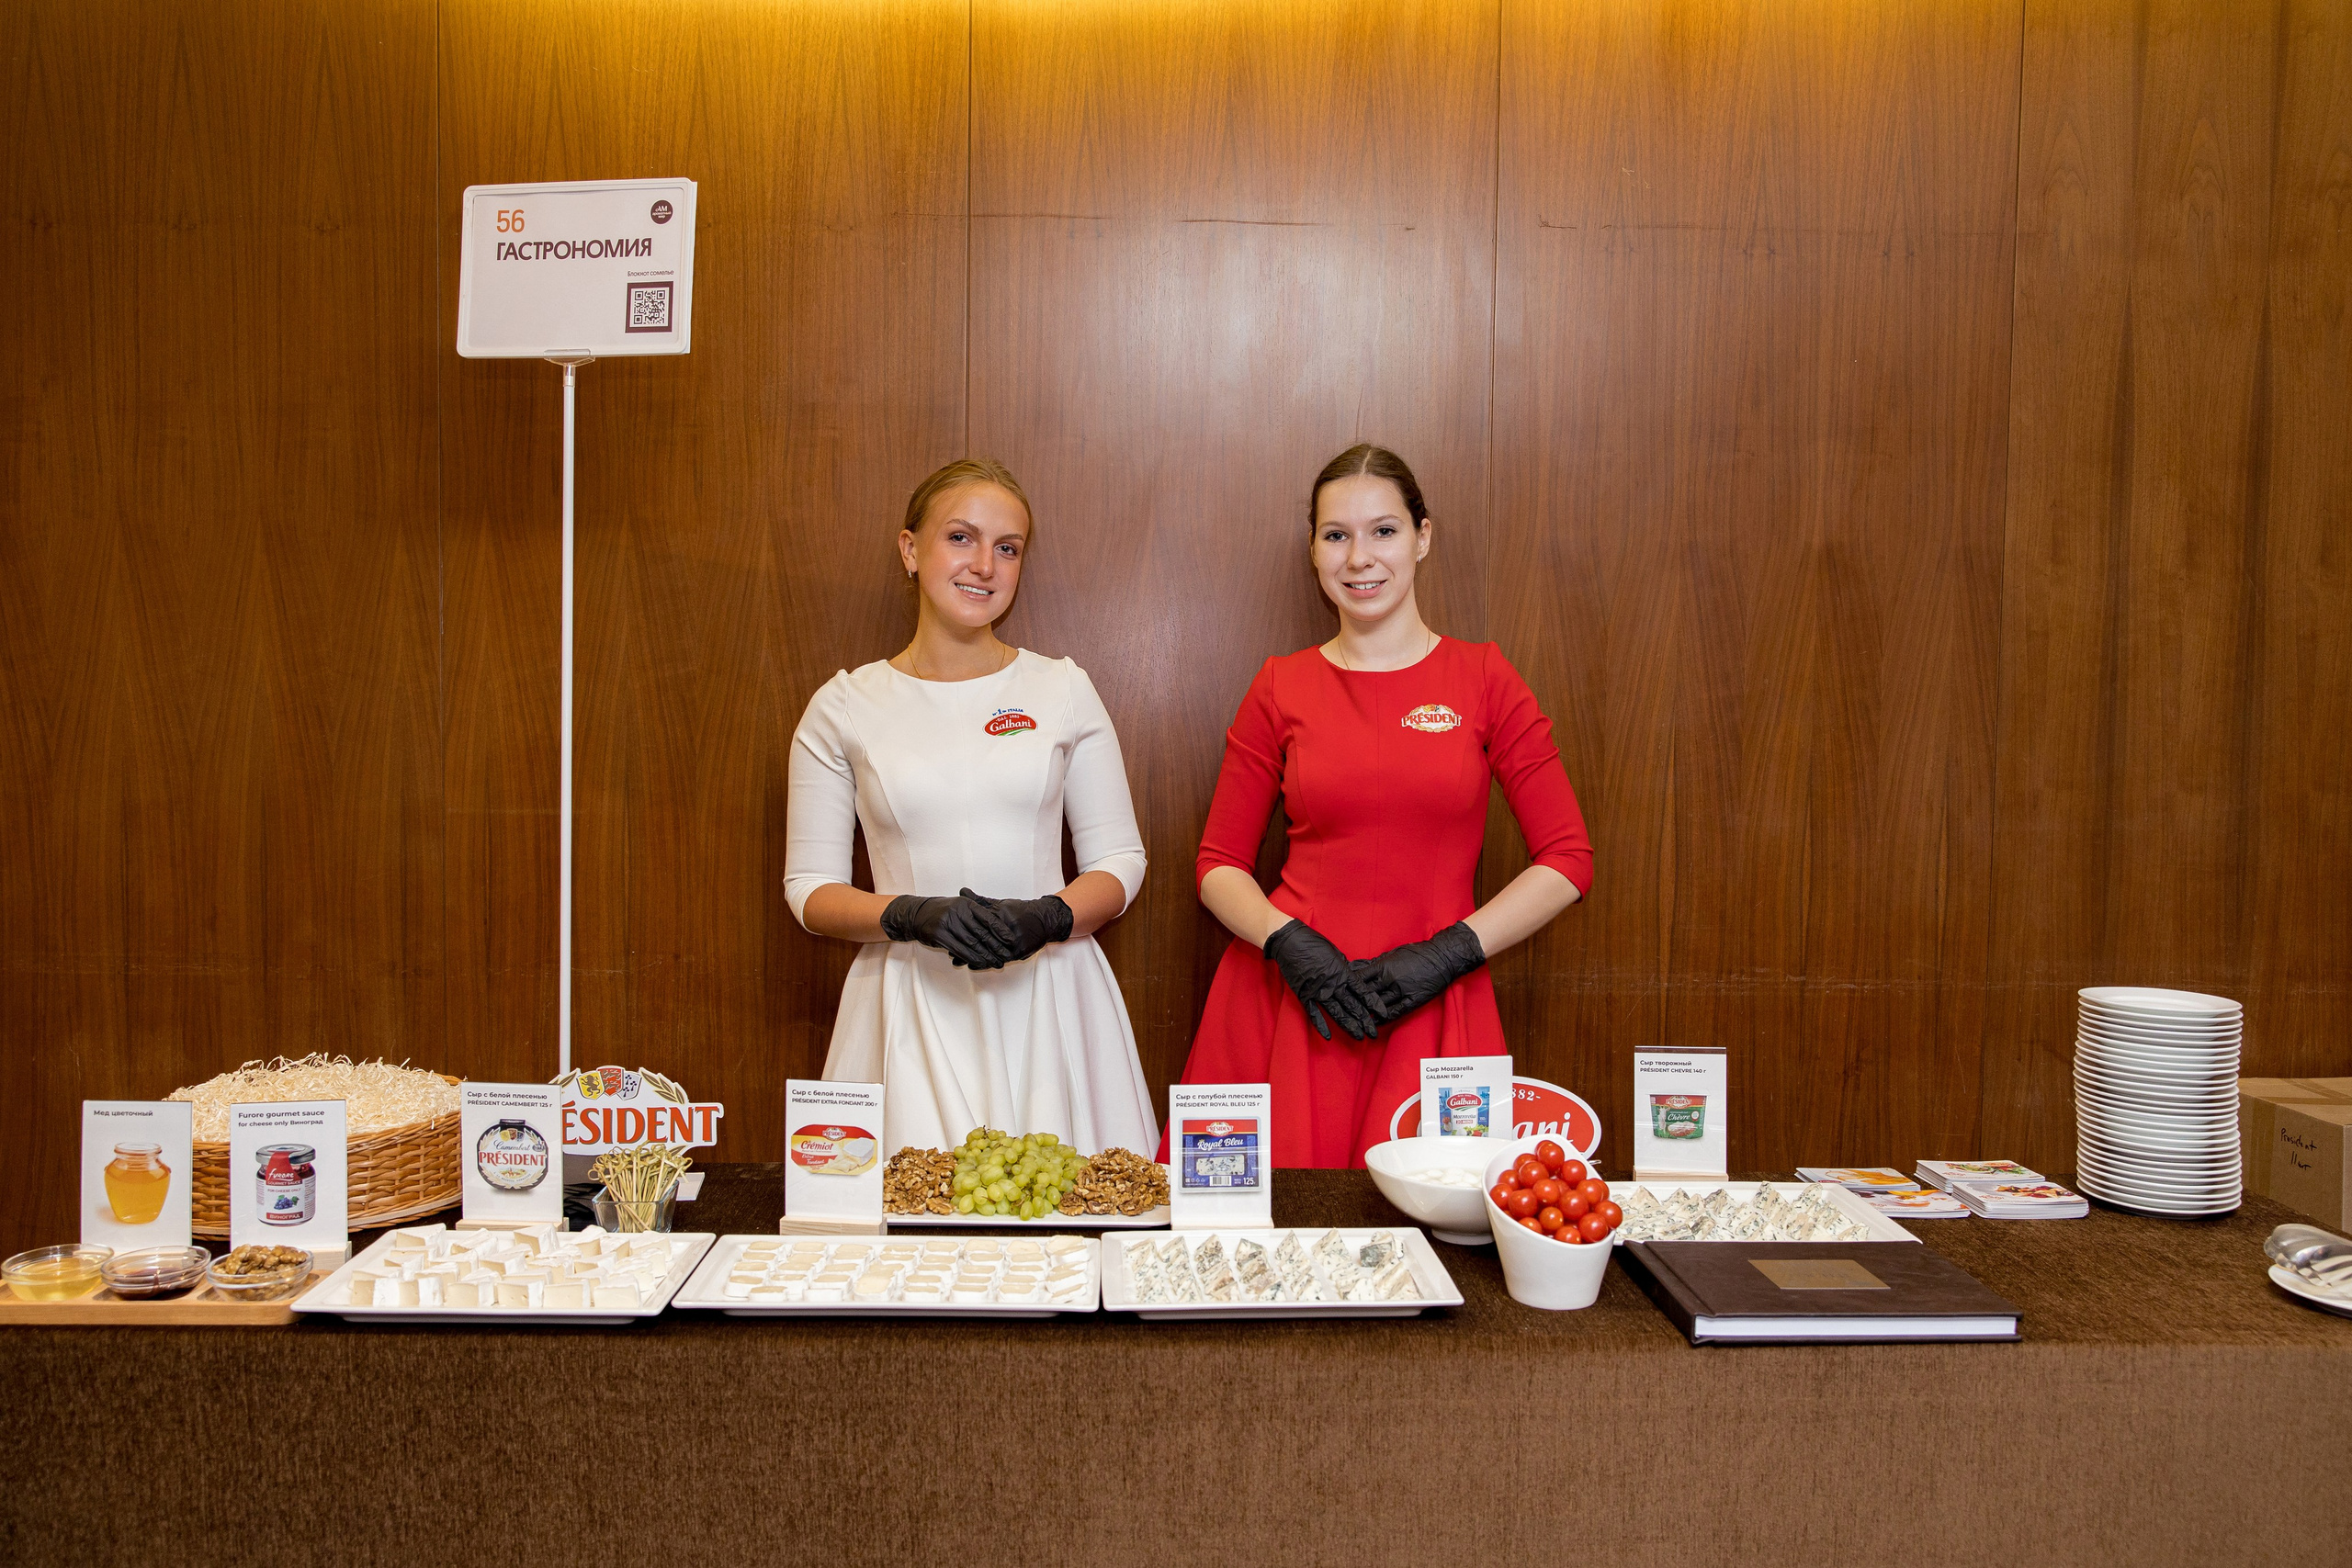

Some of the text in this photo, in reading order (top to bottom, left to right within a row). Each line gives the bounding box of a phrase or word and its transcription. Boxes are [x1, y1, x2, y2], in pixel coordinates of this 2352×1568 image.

[496, 209, 525, 233] 56
[497, 238, 651, 260] ГАСТРОНОМИЯ
[989, 720, 1032, 731] Galbani
[1403, 713, 1461, 725] PRÉSIDENT
[1450, 1097, 1478, 1106] Galbani
[266, 1111, 300, 1119] gourmet
[562, 1100, 720, 1145] ÉSIDENT
[1511, 1111, 1574, 1143] ani
[493, 1139, 531, 1151] Camembert
[800, 1140, 834, 1150] Crémiot
[1197, 1137, 1244, 1151] Royal Bleu
[479, 1151, 547, 1167] PRÉSIDENT
